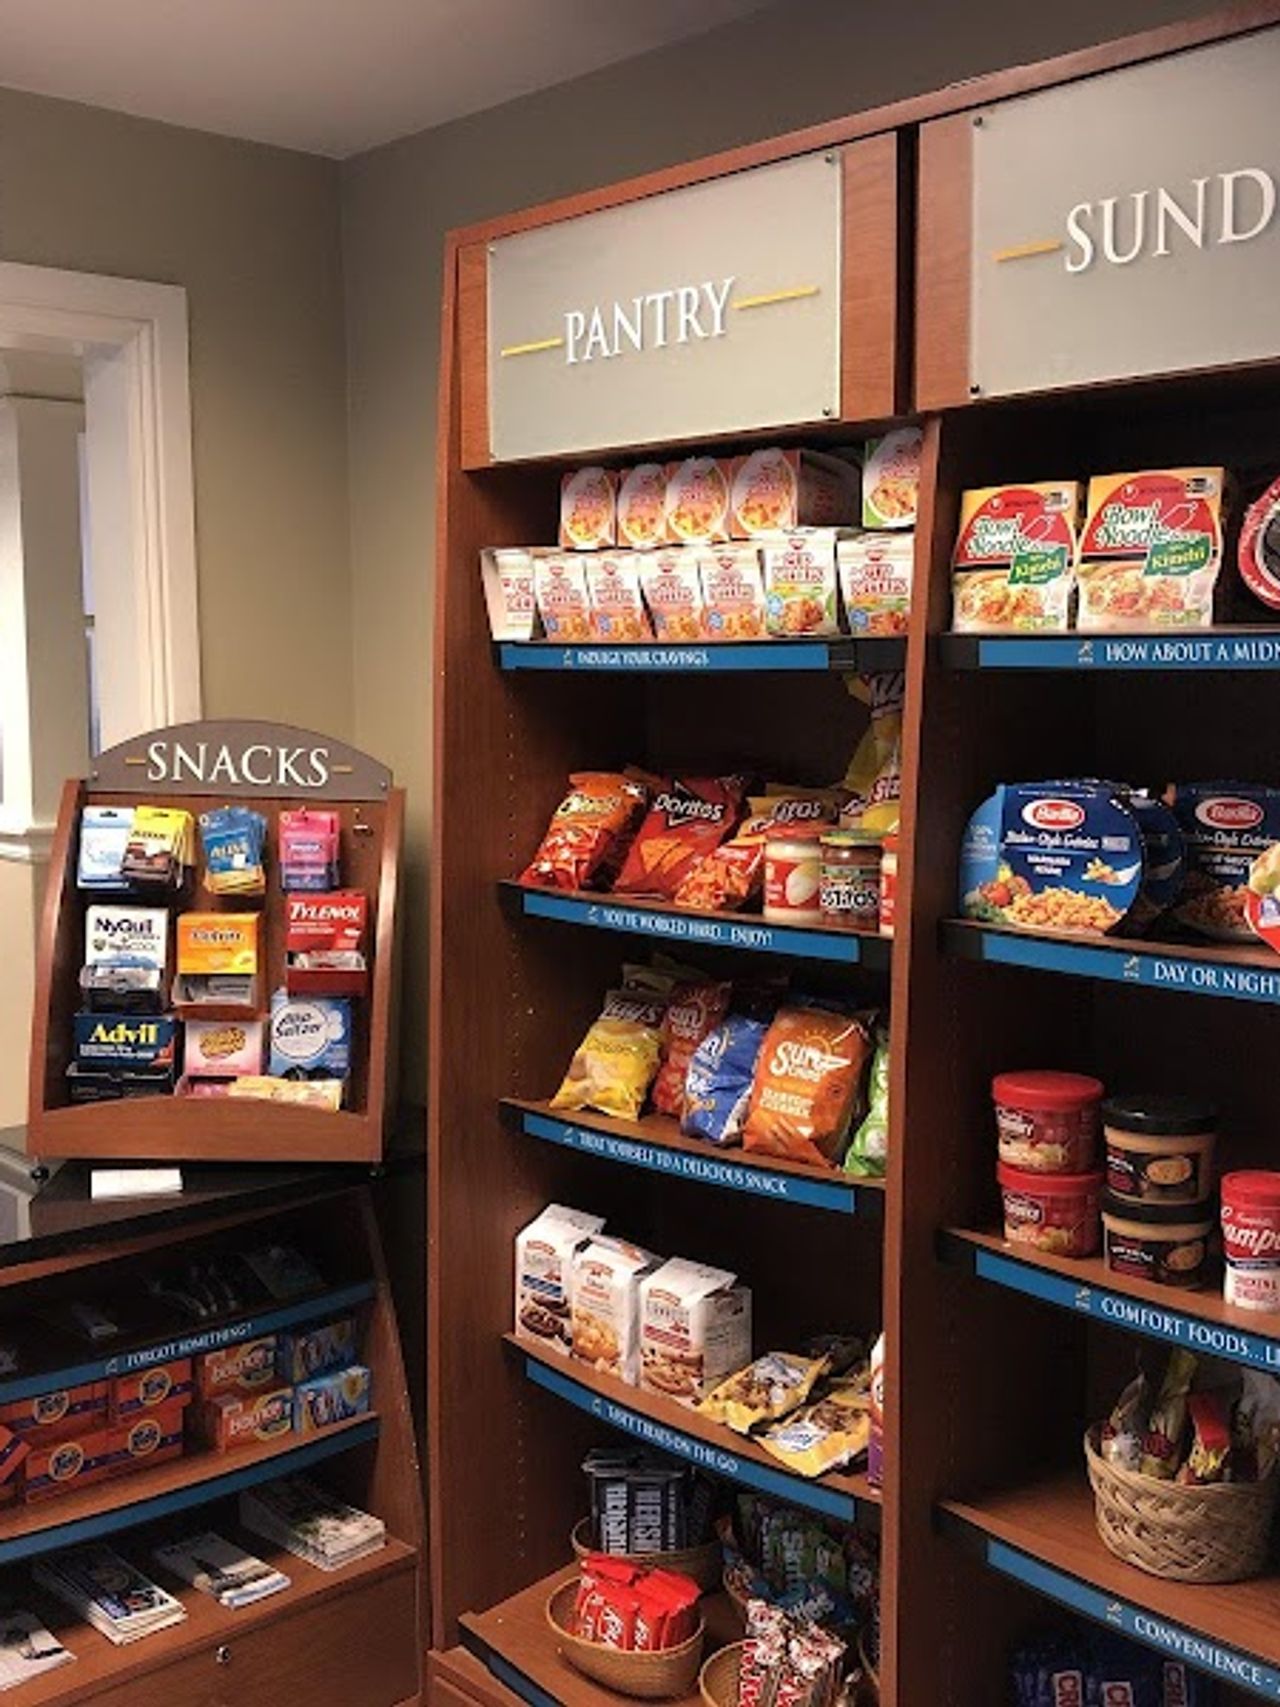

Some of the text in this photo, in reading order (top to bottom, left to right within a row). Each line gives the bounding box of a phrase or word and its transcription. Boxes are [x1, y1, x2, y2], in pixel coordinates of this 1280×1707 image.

[564, 277, 735, 364] PANTRY
[1106, 643, 1148, 662] HOW
[1152, 643, 1212, 662] ABOUT
[1216, 644, 1230, 662] A
[147, 742, 330, 787] SNACKS
[289, 901, 361, 921] TYLENOL
[94, 917, 153, 937] NyQuil
[1154, 962, 1187, 983] DAY
[1191, 967, 1218, 988] OR
[89, 1023, 158, 1046] Advil
[682, 1157, 744, 1185] DELICIOUS
[745, 1172, 790, 1194] SNACK
[1101, 1297, 1184, 1337] COMFORT
[717, 1454, 738, 1473] GO
[1134, 1615, 1262, 1686] CONVENIENCE
